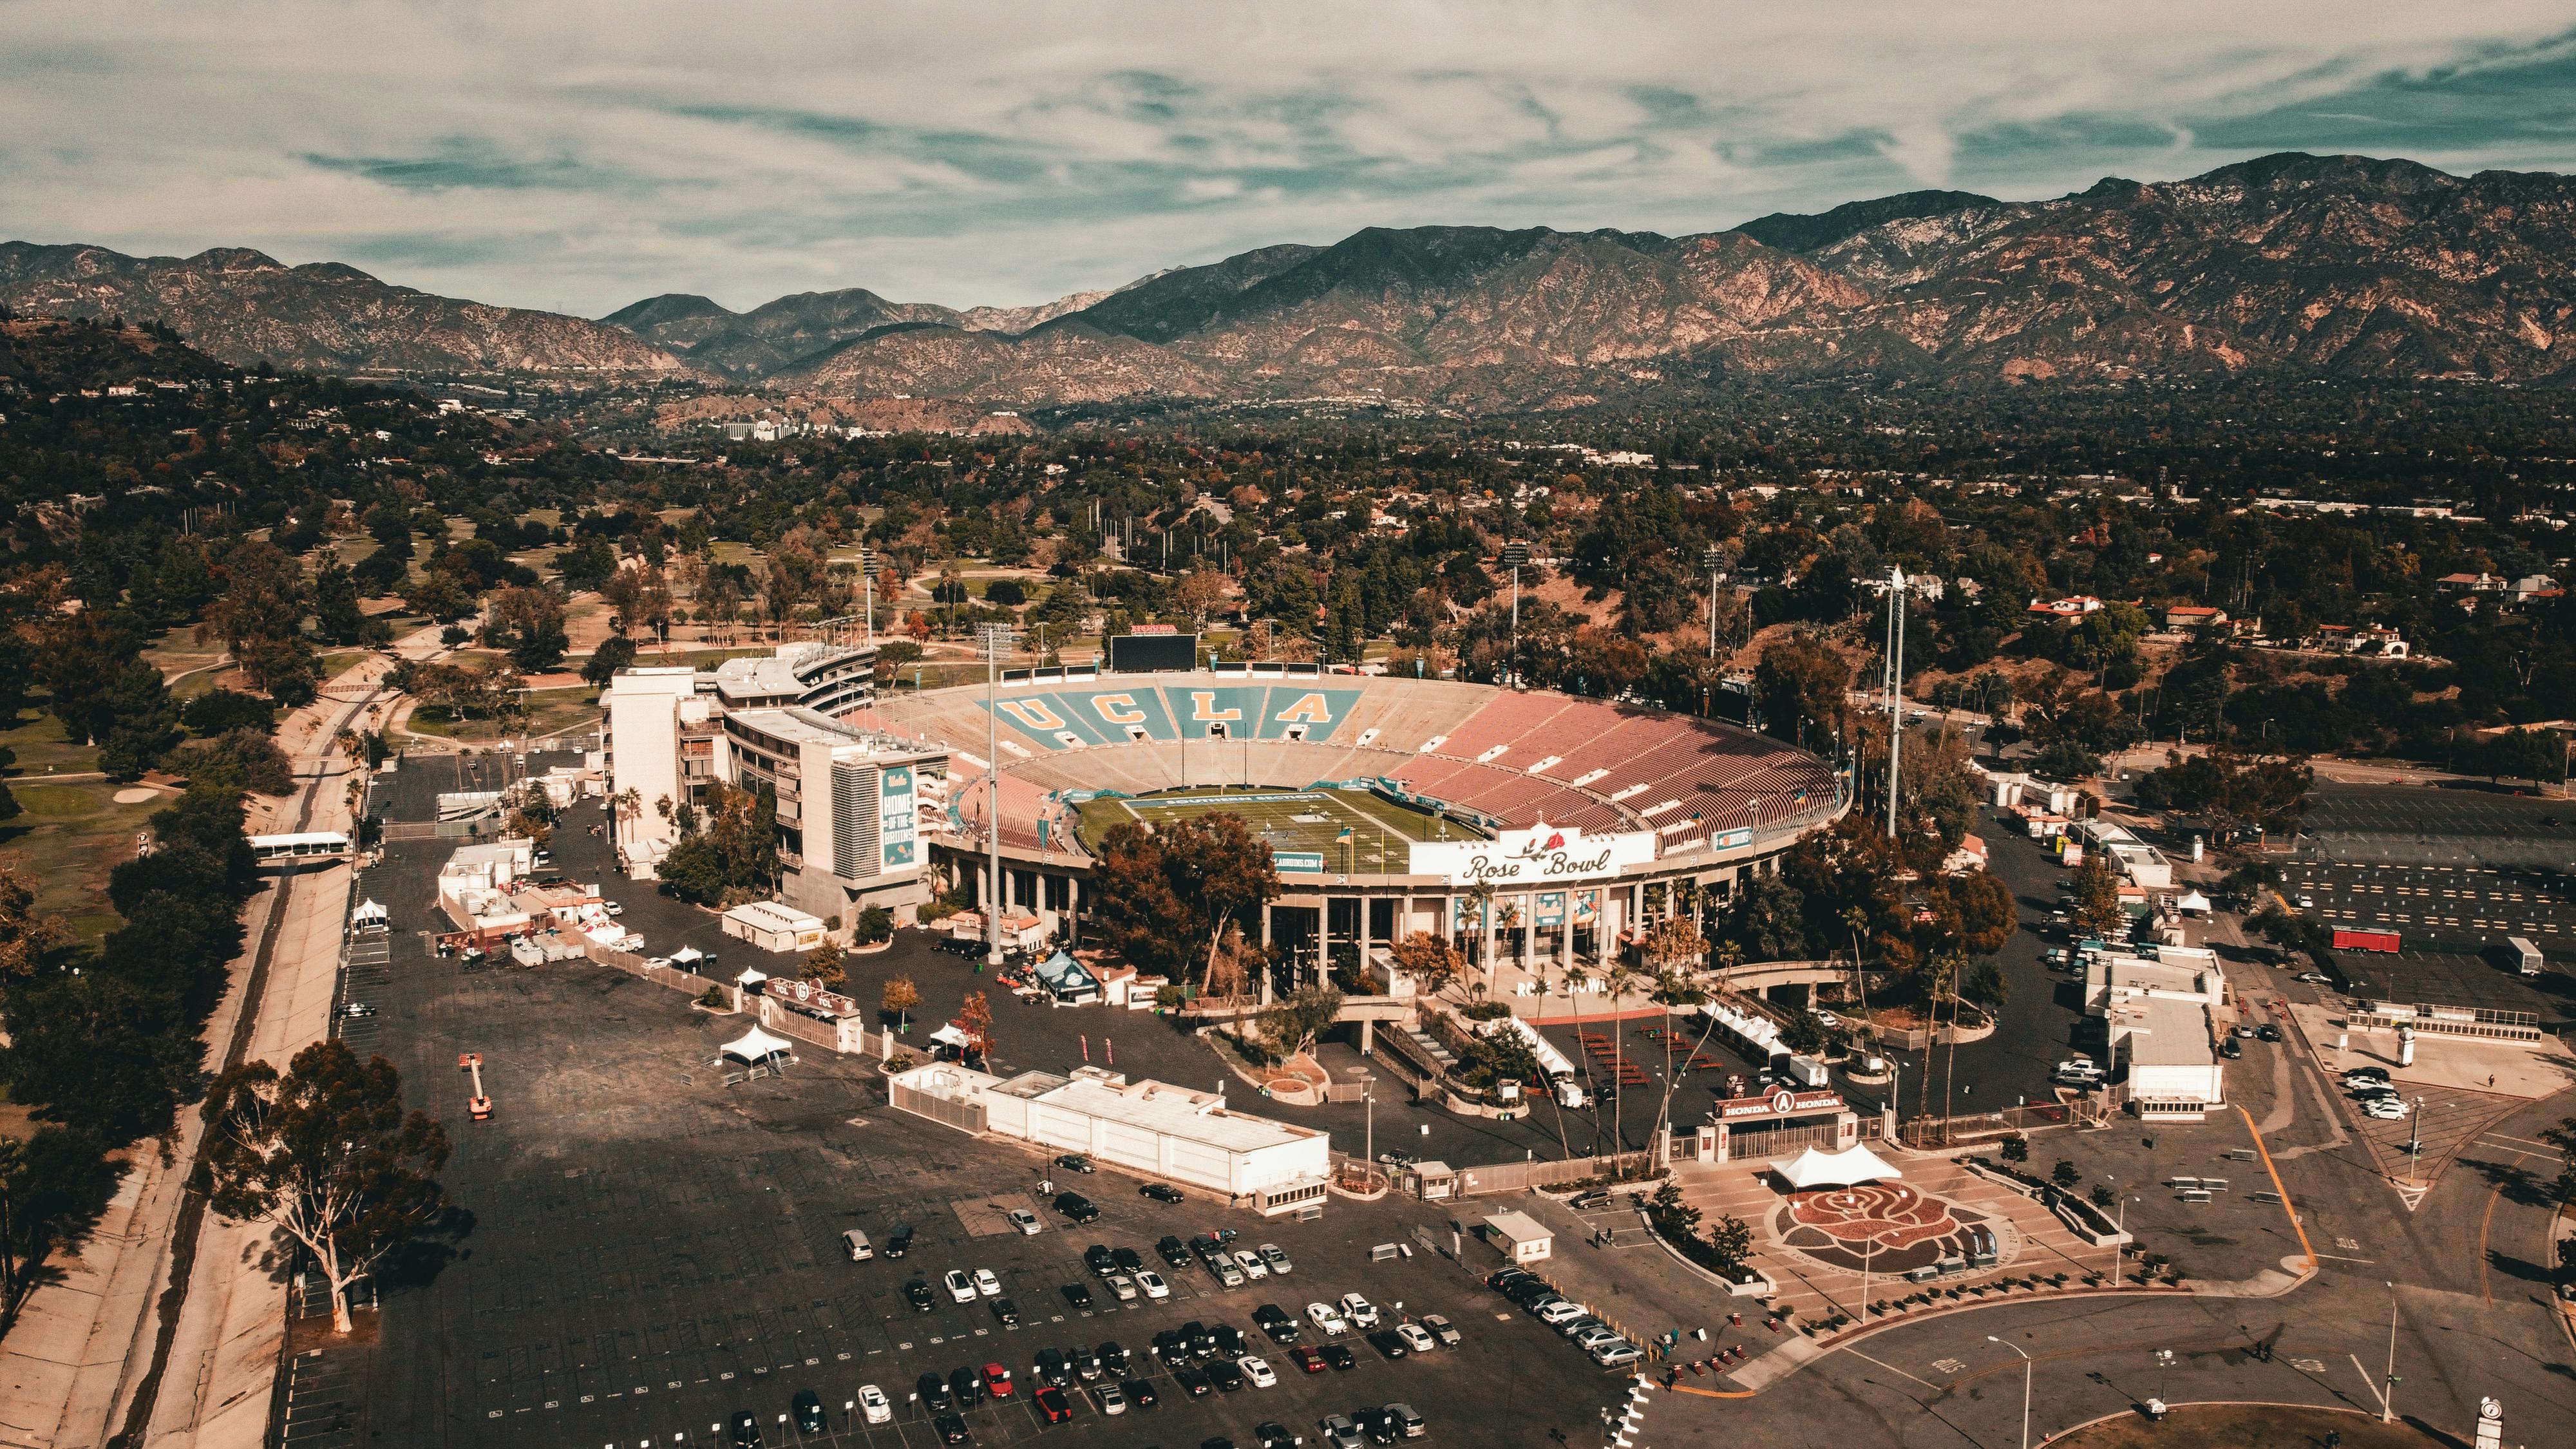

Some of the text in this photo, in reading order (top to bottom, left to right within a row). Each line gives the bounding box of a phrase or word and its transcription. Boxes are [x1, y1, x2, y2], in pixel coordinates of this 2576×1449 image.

[997, 692, 1332, 730] UCLA
[884, 793, 912, 815] HOME
[1166, 796, 1252, 804] SOUTHERN
[889, 815, 909, 829] OF THE
[885, 828, 913, 846] BRUINS
[1463, 849, 1611, 878] Rose Bowl
[774, 985, 788, 995] TCL
[1517, 981, 1551, 997] ROE
[817, 998, 832, 1009] TCL
[1778, 1094, 1789, 1111] A
[1795, 1098, 1840, 1109] HONDA
[1725, 1105, 1770, 1116] HONDA
